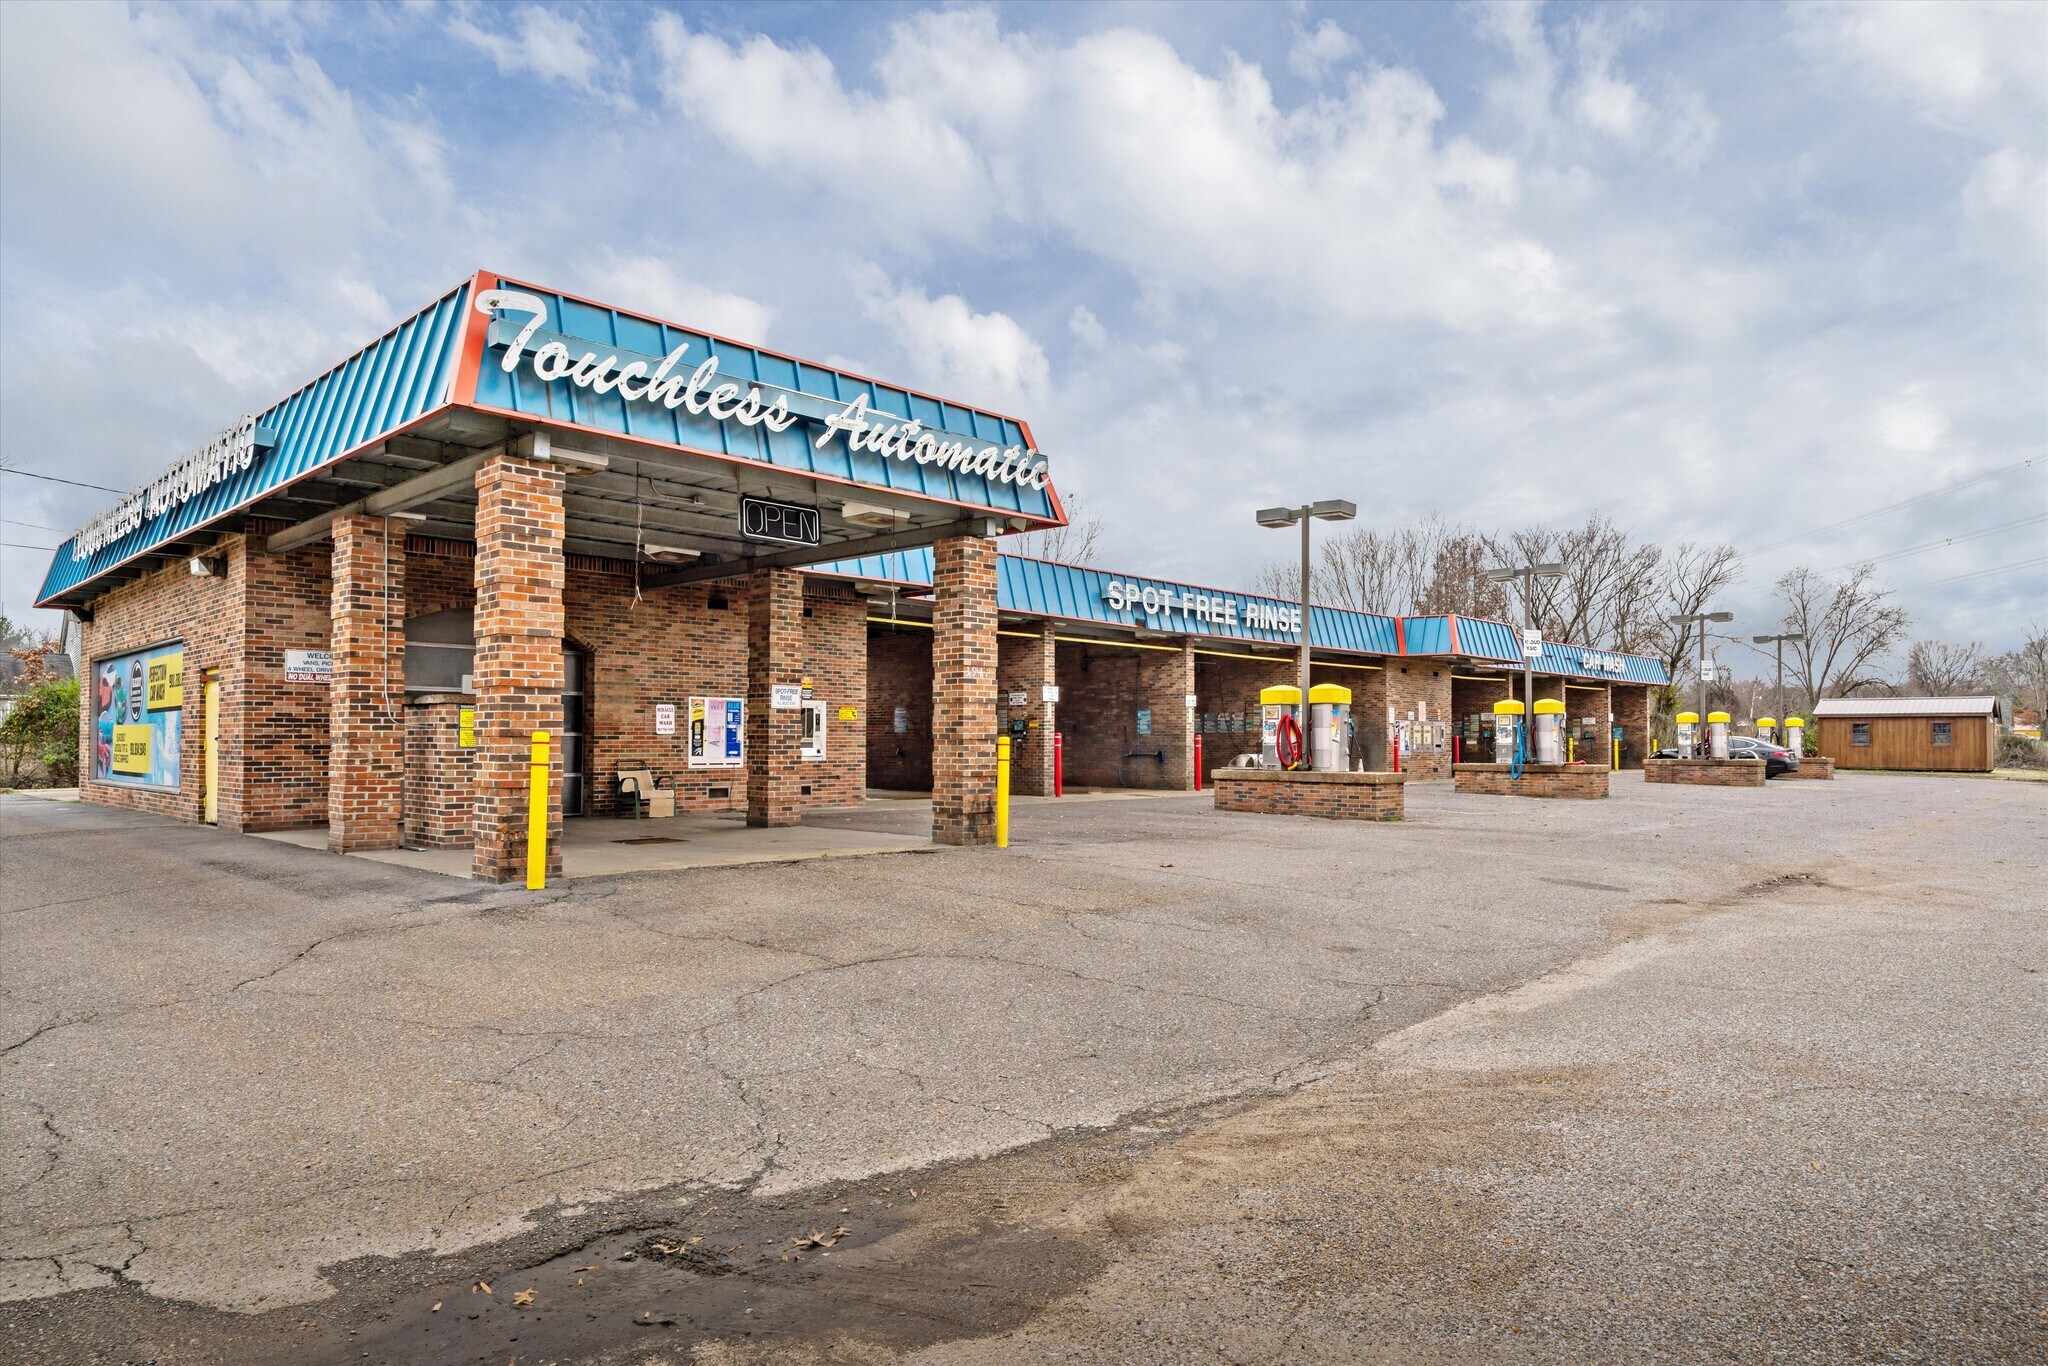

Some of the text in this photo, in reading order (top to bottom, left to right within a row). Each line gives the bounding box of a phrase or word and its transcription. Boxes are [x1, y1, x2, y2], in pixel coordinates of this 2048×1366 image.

[475, 289, 1051, 492] Touchless Automatic
[746, 502, 816, 542] OPEN
[1108, 580, 1302, 633] SPOT FREE RINSE
[1583, 652, 1625, 673] CAR WASH
